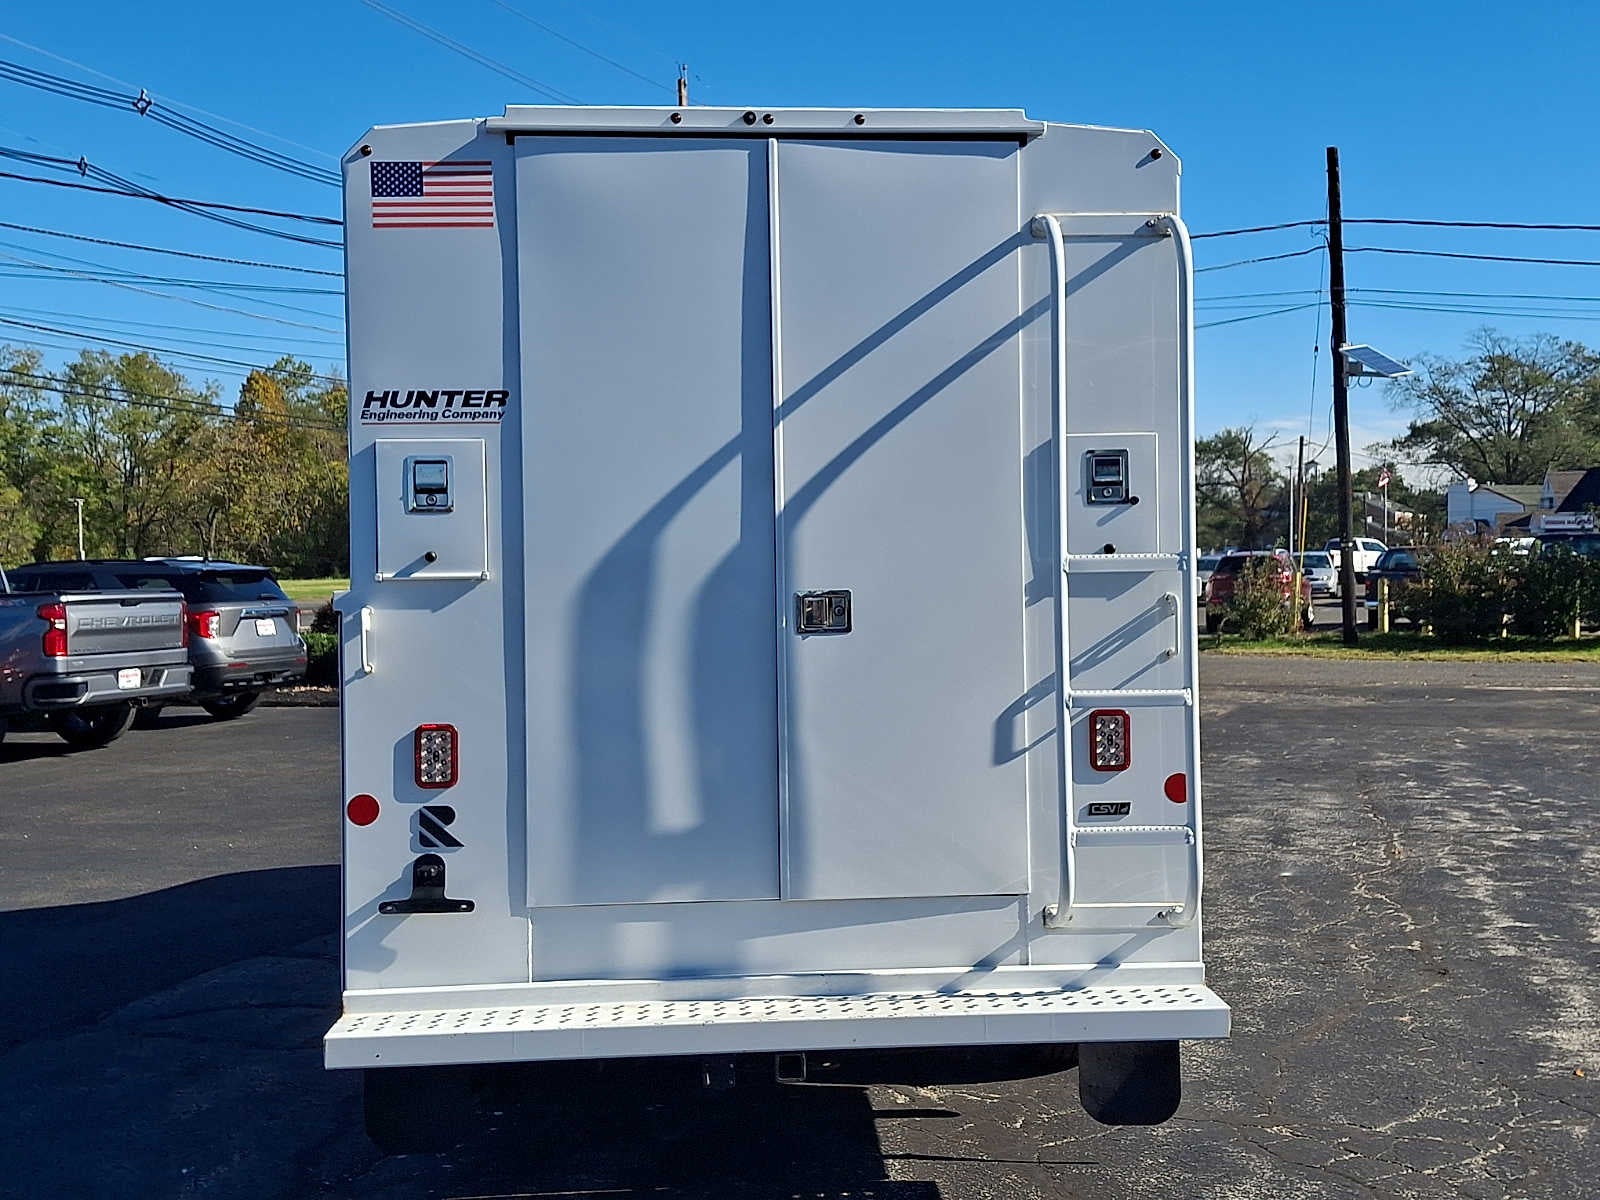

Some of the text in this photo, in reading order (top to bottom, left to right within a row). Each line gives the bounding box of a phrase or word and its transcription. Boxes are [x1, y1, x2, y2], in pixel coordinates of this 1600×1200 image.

[362, 390, 510, 409] HUNTER
[360, 408, 506, 421] Engineering Company
[78, 614, 180, 629] CHEVROLET
